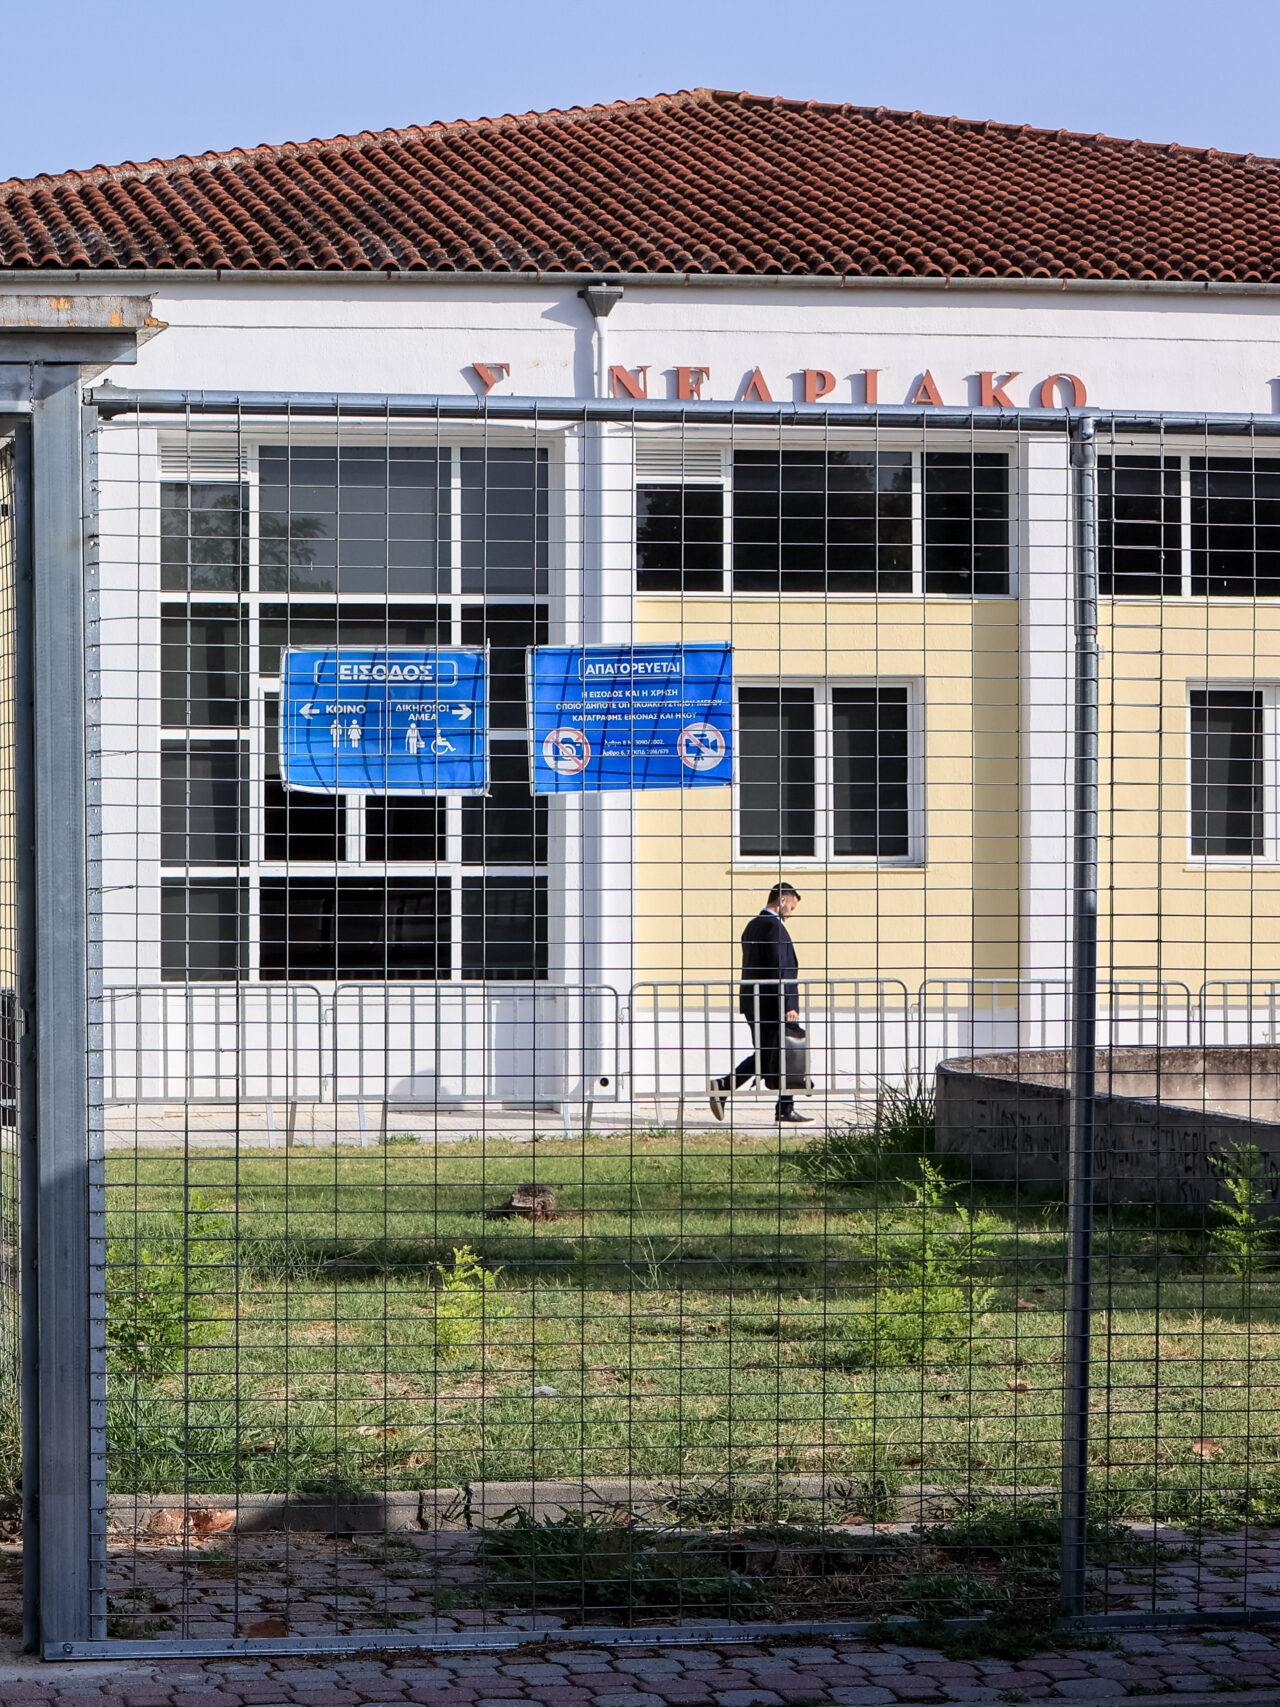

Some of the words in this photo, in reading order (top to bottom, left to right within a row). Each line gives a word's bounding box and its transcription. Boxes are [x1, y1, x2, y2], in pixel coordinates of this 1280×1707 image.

[339, 664, 433, 681] ΕΙΣΟΔΟΣ
[585, 662, 680, 675] ΑΠΑΓΟΡΕΥΕΤΑΙ
[589, 690, 623, 699] ΕΙΣΟΔΟΣ
[625, 690, 640, 698] ΚΑΙ
[642, 689, 648, 697] Η
[650, 689, 679, 697] ΧΡΗΣΗ
[325, 704, 367, 714] ΚΟΙΝΟ
[408, 713, 439, 721] ΑΜΕΑ
[572, 713, 623, 722] ΚΑΤΑΓΡΑΦΗΣ
[624, 712, 659, 721] ΕΙΚΟΝΑΣ
[660, 712, 674, 720] ΚΑΙ
